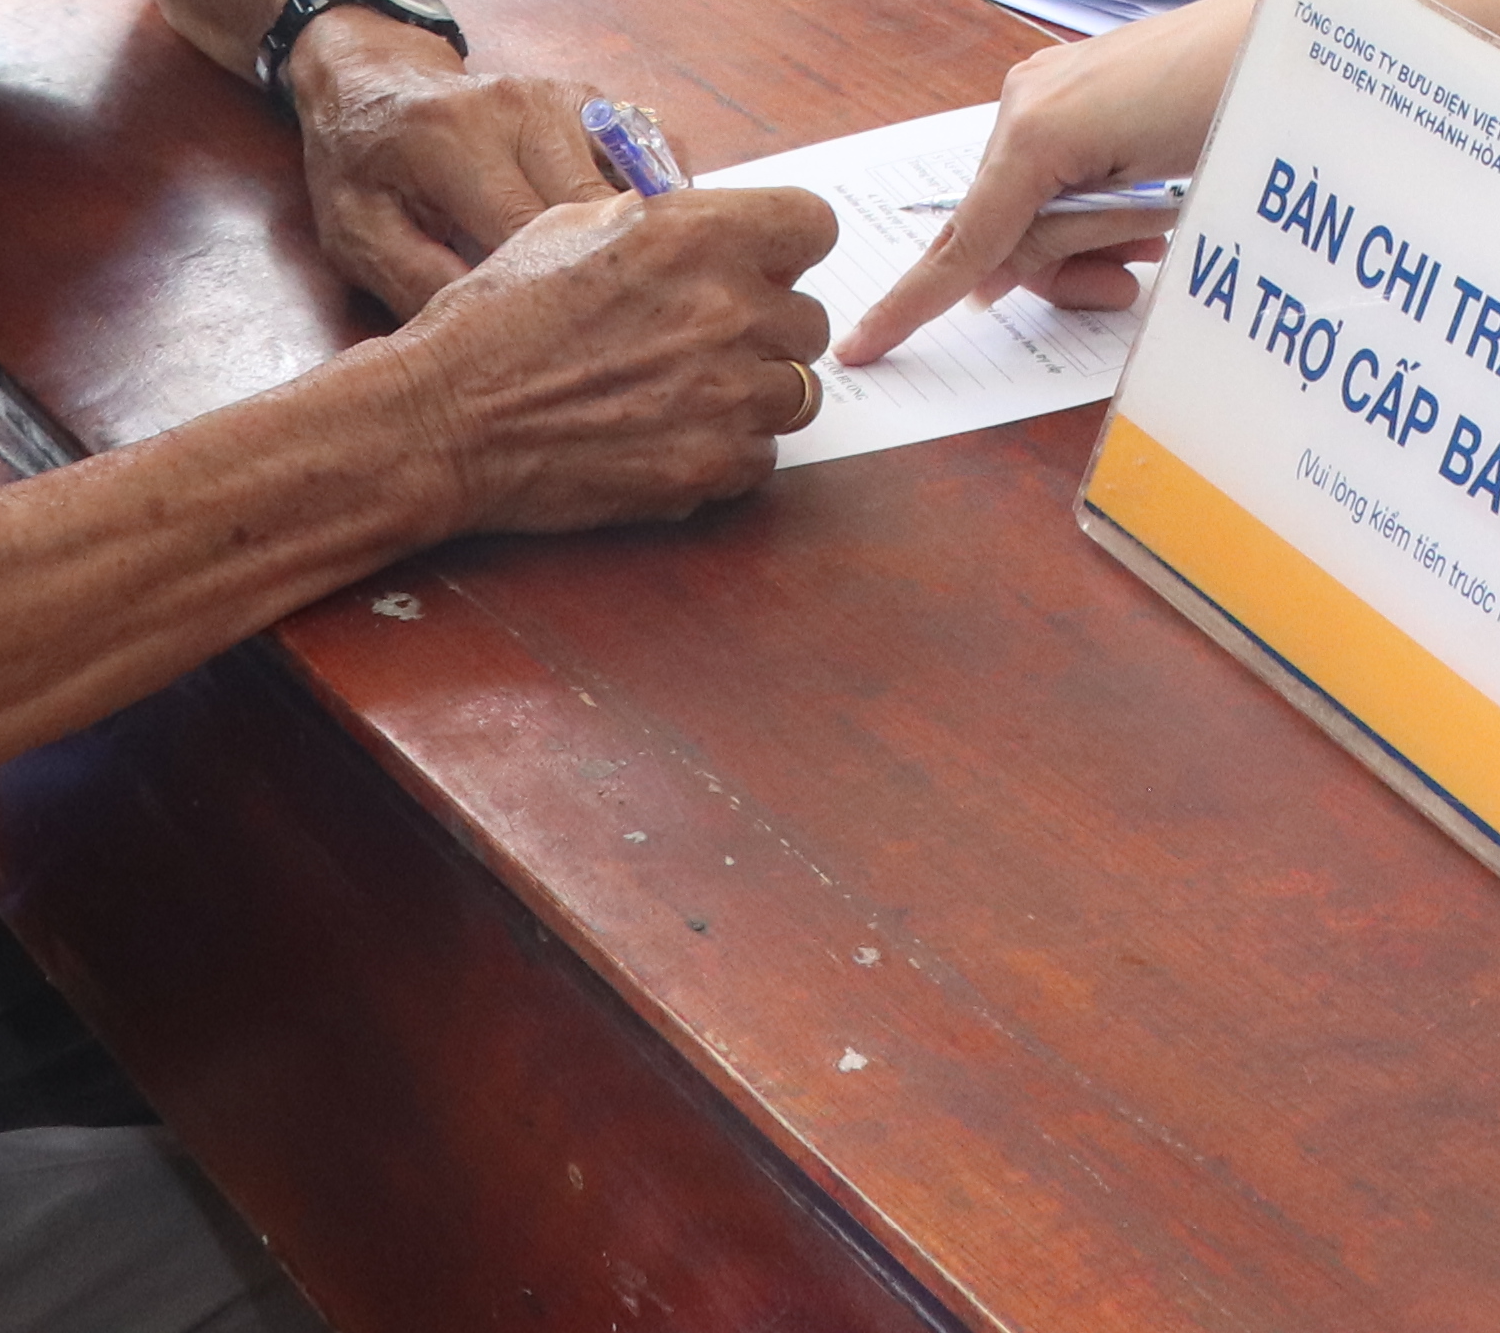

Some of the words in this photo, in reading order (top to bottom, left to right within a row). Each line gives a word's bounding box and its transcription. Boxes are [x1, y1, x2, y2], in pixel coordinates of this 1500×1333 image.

[1294, 0, 1331, 35] TỔNG
[1333, 25, 1375, 62] CÔNG
[1378, 50, 1398, 74] TY
[1396, 63, 1432, 96] BƯU
[1432, 84, 1470, 119] ĐIỆN
[1309, 40, 1342, 72] BƯU
[1342, 61, 1378, 95] ĐIỆN
[1379, 82, 1413, 117] TỈNH
[1413, 105, 1469, 151] KHÁNH
[1257, 158, 1353, 263] BÀN
[1355, 225, 1440, 321] CHI
[1188, 233, 1240, 321] VÀ
[1249, 276, 1342, 390] TRỢ
[1341, 348, 1438, 446] CẤP
[1296, 448, 1331, 489] (Vui
[1329, 471, 1367, 523] lòng
[1368, 499, 1410, 550] kiểm
[1413, 533, 1446, 577] tiền
[1448, 560, 1495, 613] trước
